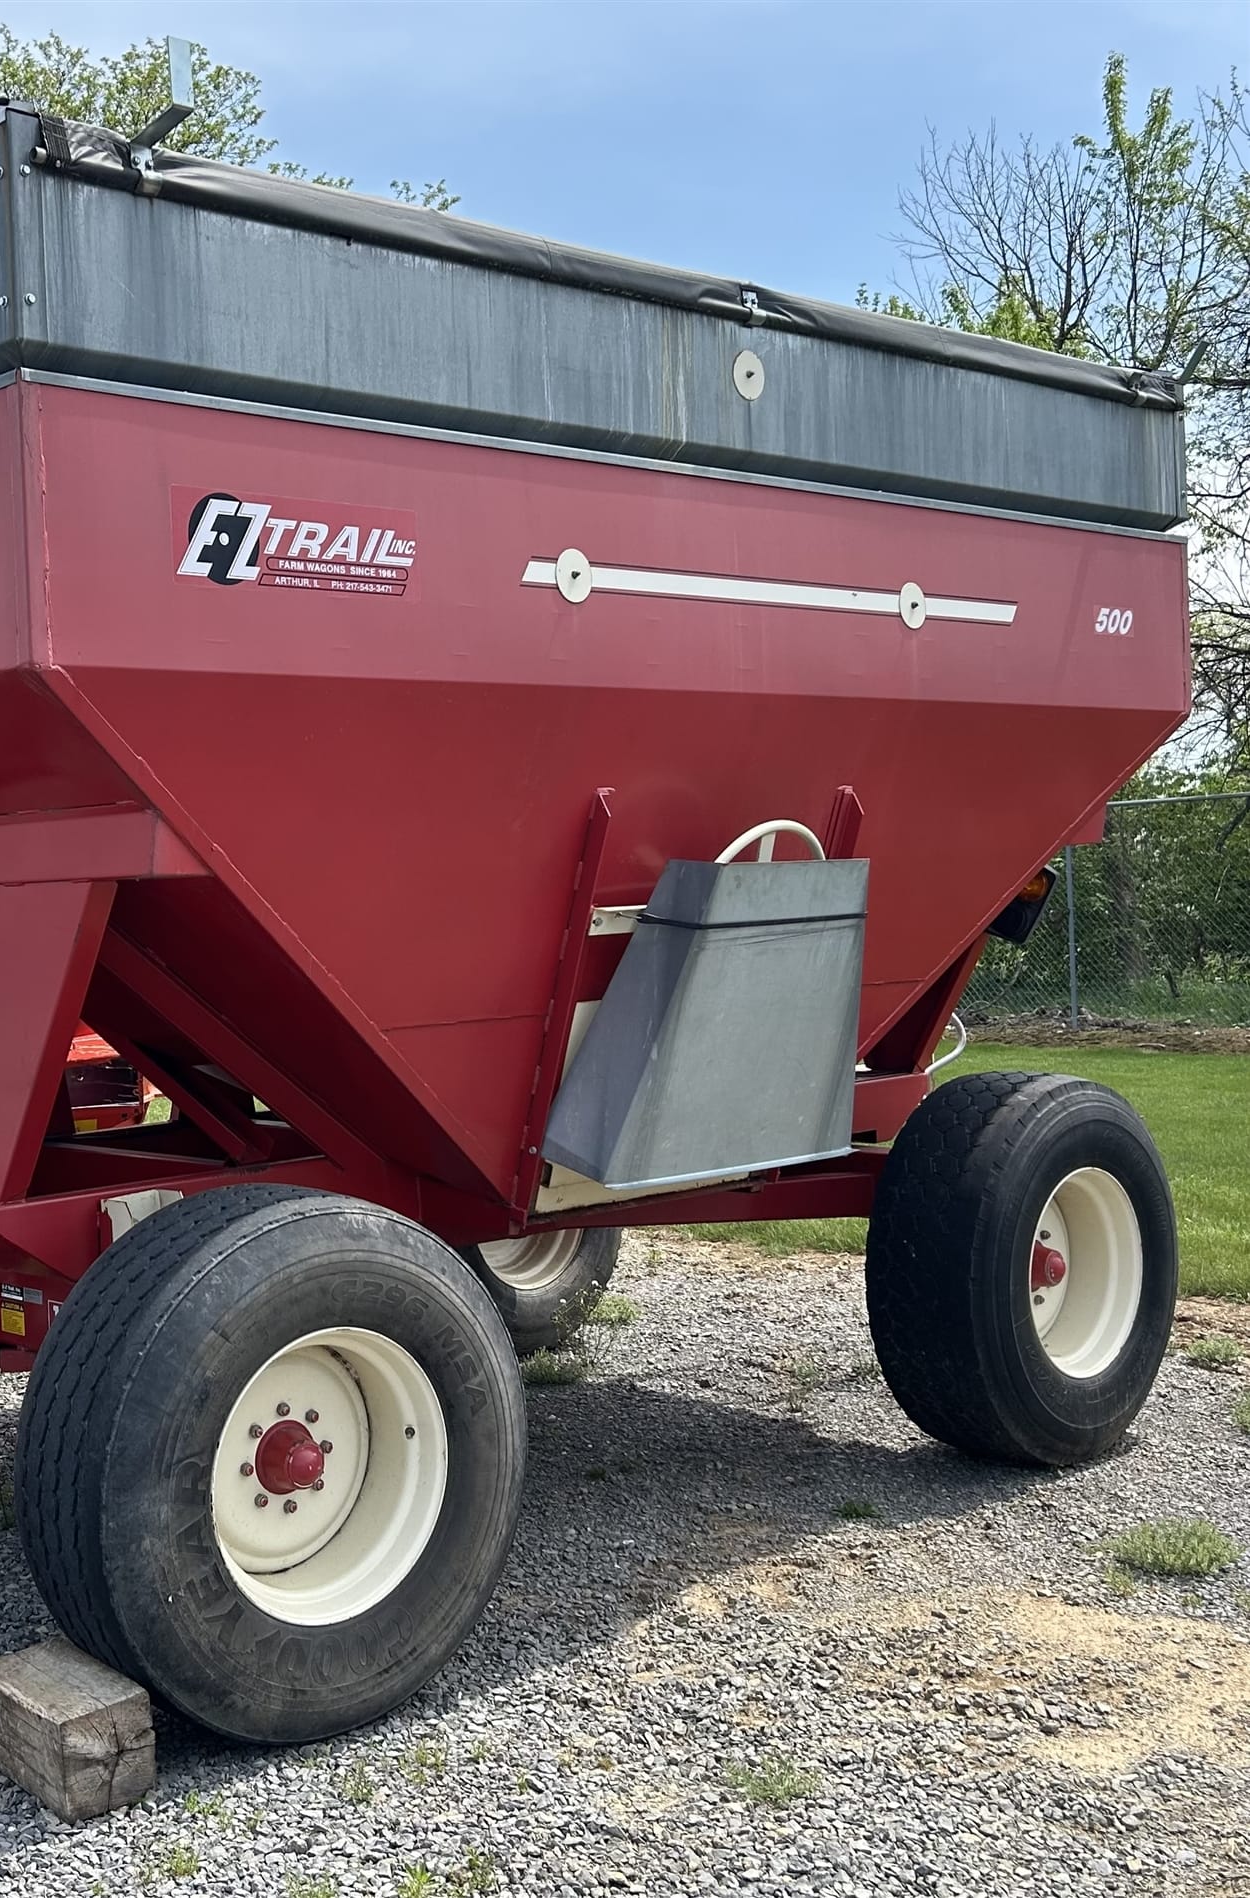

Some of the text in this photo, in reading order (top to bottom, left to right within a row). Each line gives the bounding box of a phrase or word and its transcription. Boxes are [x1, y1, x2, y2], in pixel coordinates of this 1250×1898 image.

[263, 517, 415, 567] TRAIL
[389, 538, 417, 556] INC.
[278, 560, 305, 571] FARM
[306, 561, 346, 574] WAGONS
[349, 566, 376, 577] SINCE
[1095, 607, 1133, 635] 500
